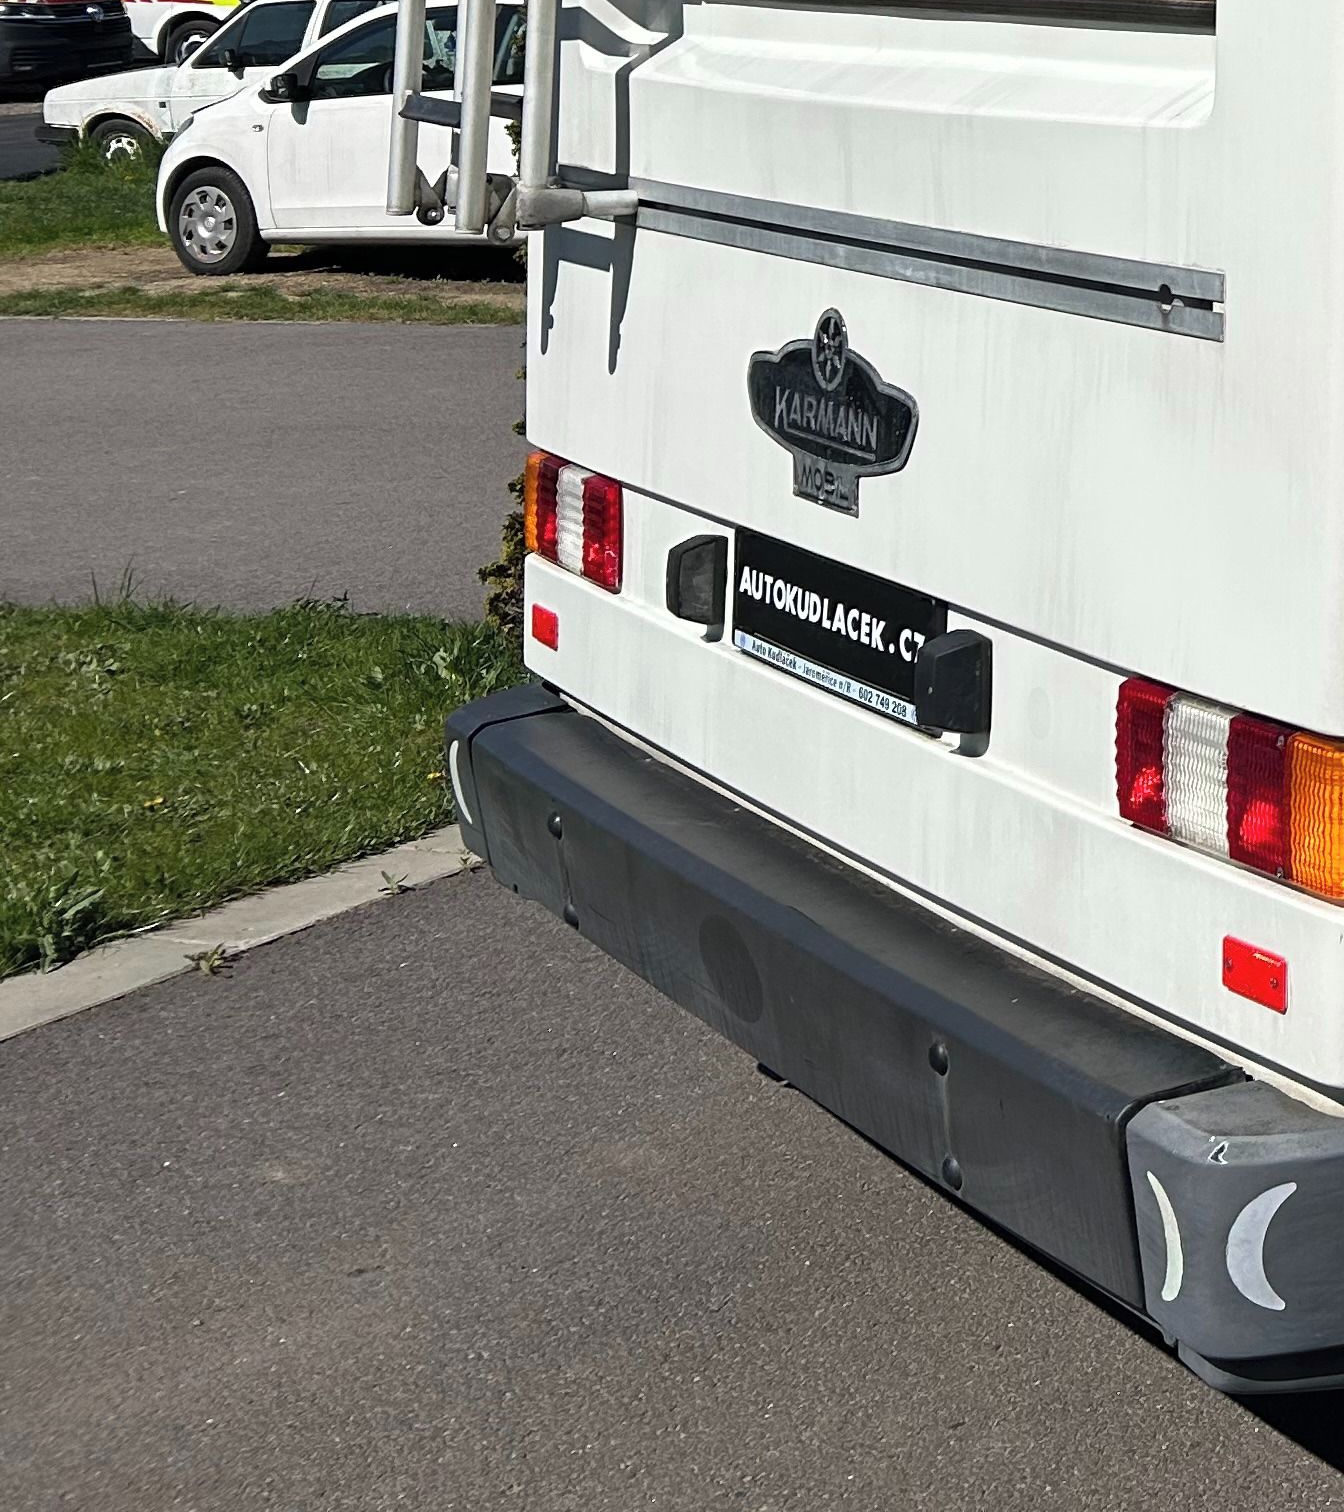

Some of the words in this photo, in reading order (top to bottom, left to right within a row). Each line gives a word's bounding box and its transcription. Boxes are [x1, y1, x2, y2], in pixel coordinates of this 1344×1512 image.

[774, 386, 879, 451] KARMANN
[752, 639, 767, 656] Auto
[858, 686, 873, 703] 602
[875, 693, 890, 711] 749
